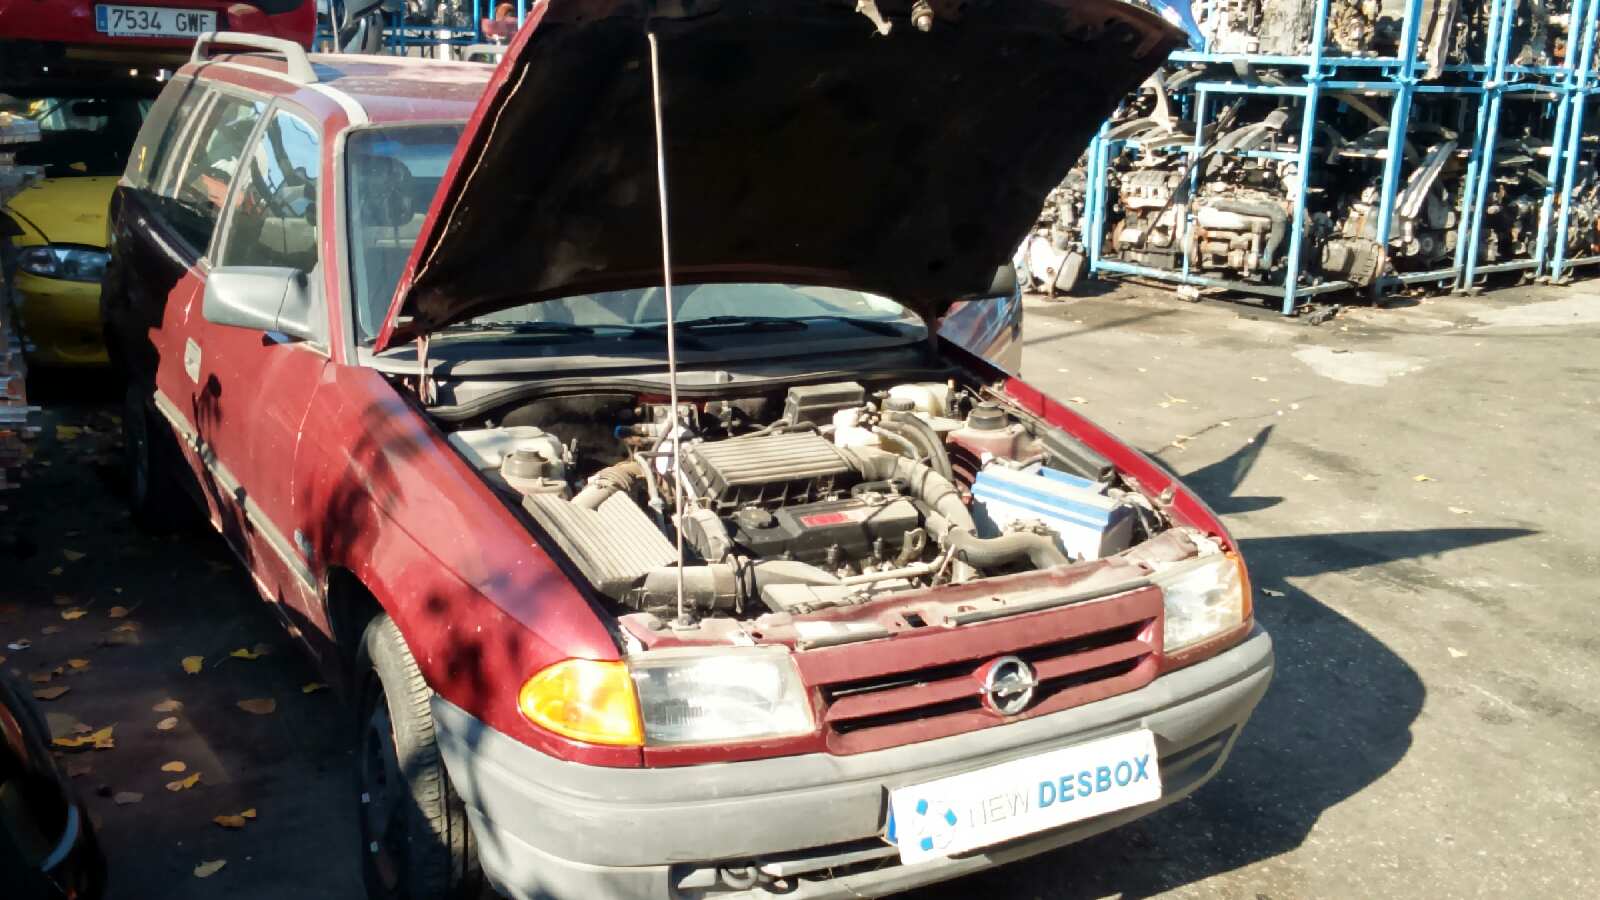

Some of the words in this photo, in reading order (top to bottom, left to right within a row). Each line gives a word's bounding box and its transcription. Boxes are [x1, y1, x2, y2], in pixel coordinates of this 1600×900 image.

[112, 9, 162, 31] 7534
[175, 12, 209, 32] GWF
[1038, 754, 1149, 808] DESBOX
